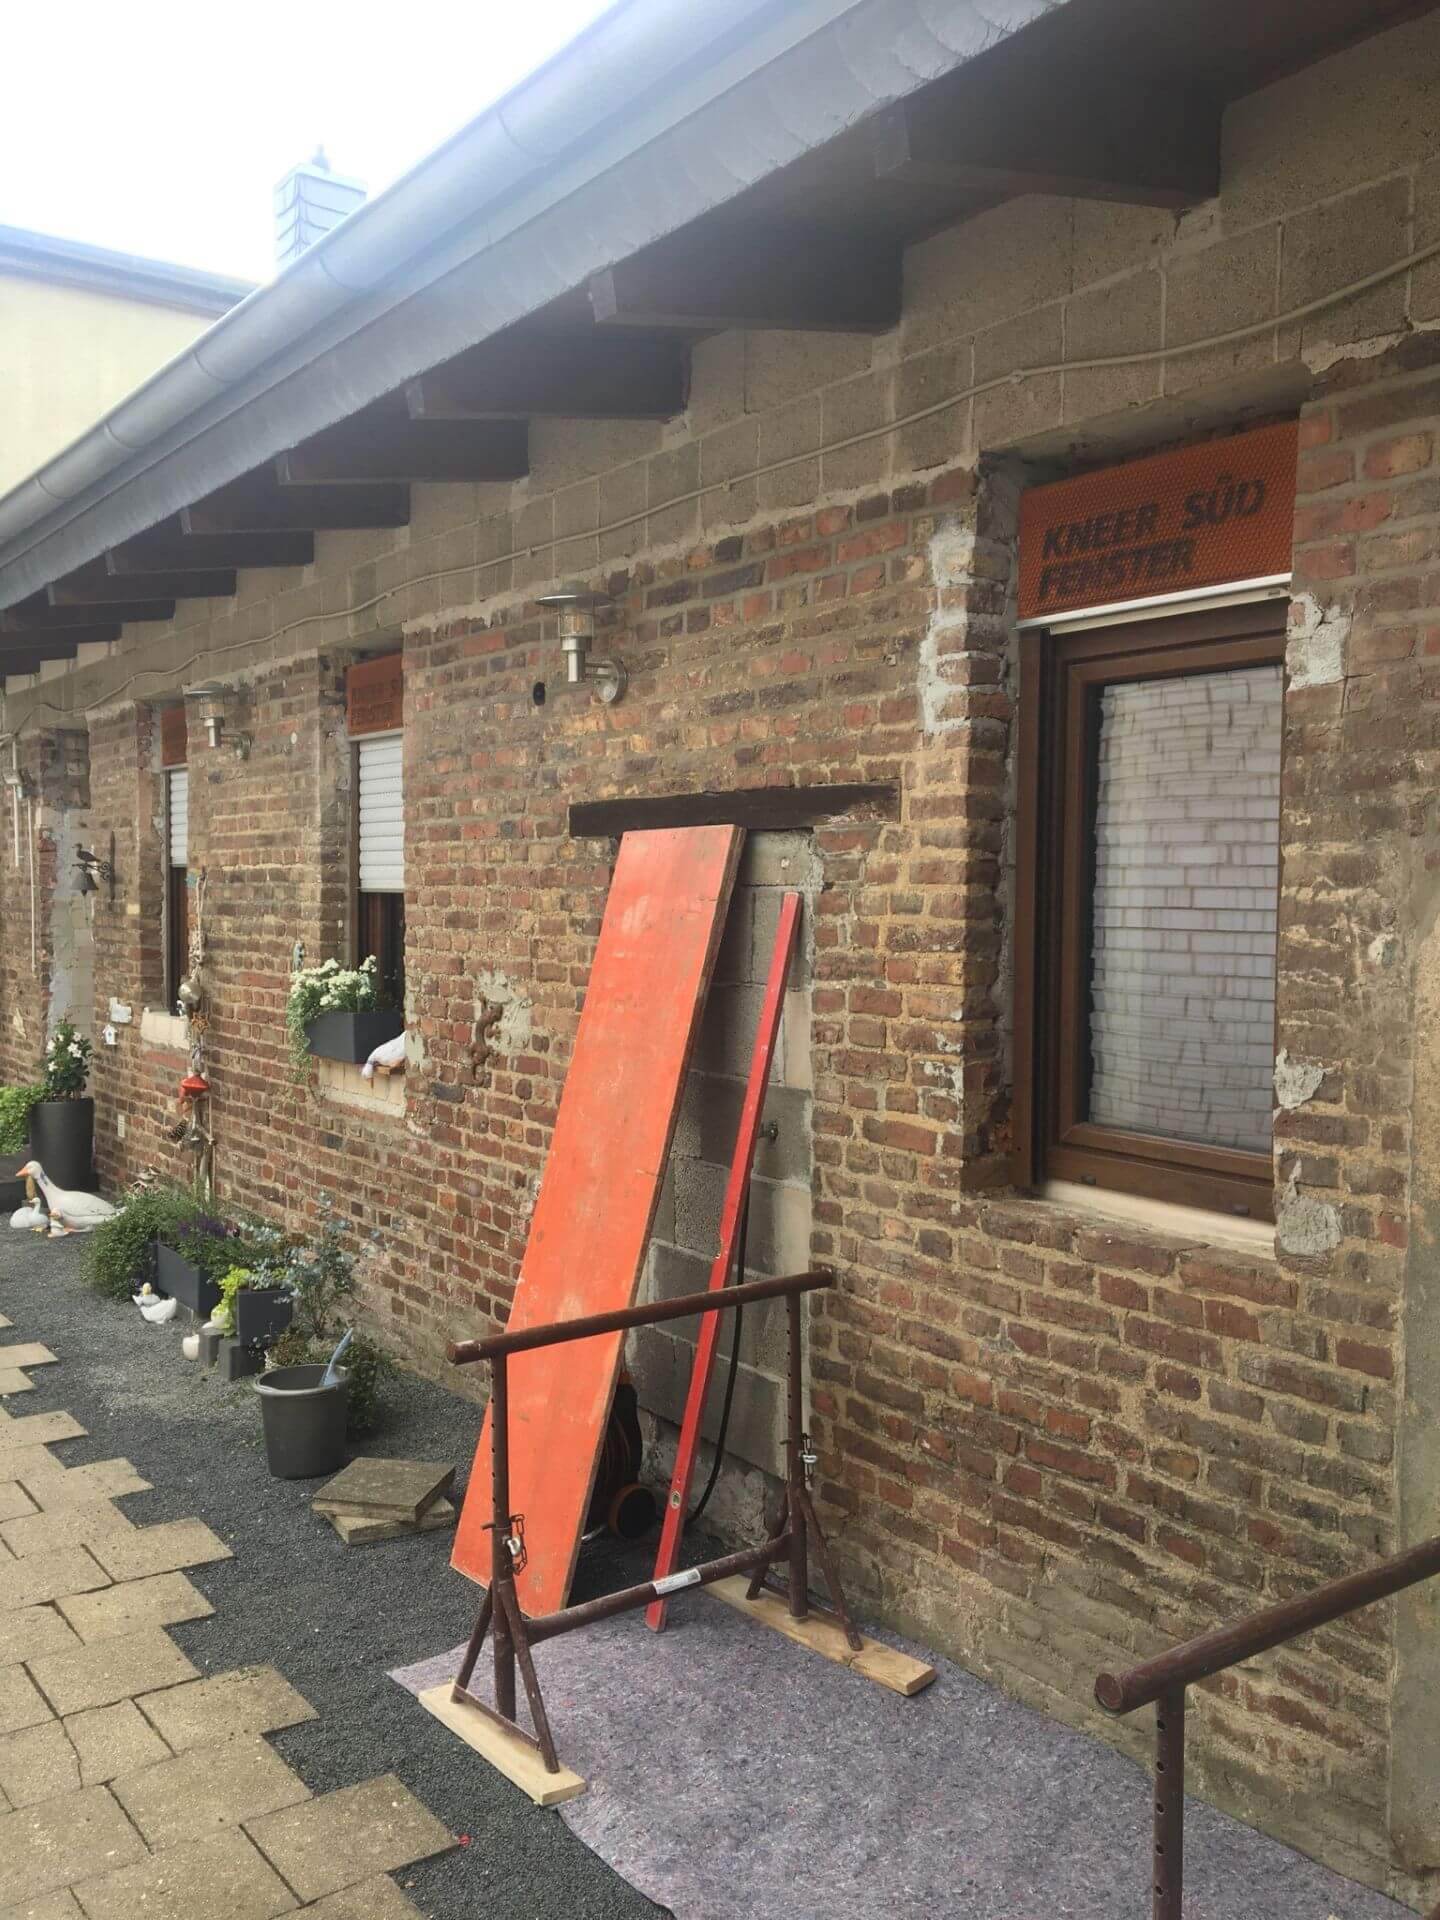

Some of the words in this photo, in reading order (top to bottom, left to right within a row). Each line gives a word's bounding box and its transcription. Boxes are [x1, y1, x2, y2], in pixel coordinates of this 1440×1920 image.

[1043, 503, 1158, 559] KNEER
[1183, 472, 1265, 528] SÜD
[1040, 538, 1195, 599] FENSTER
